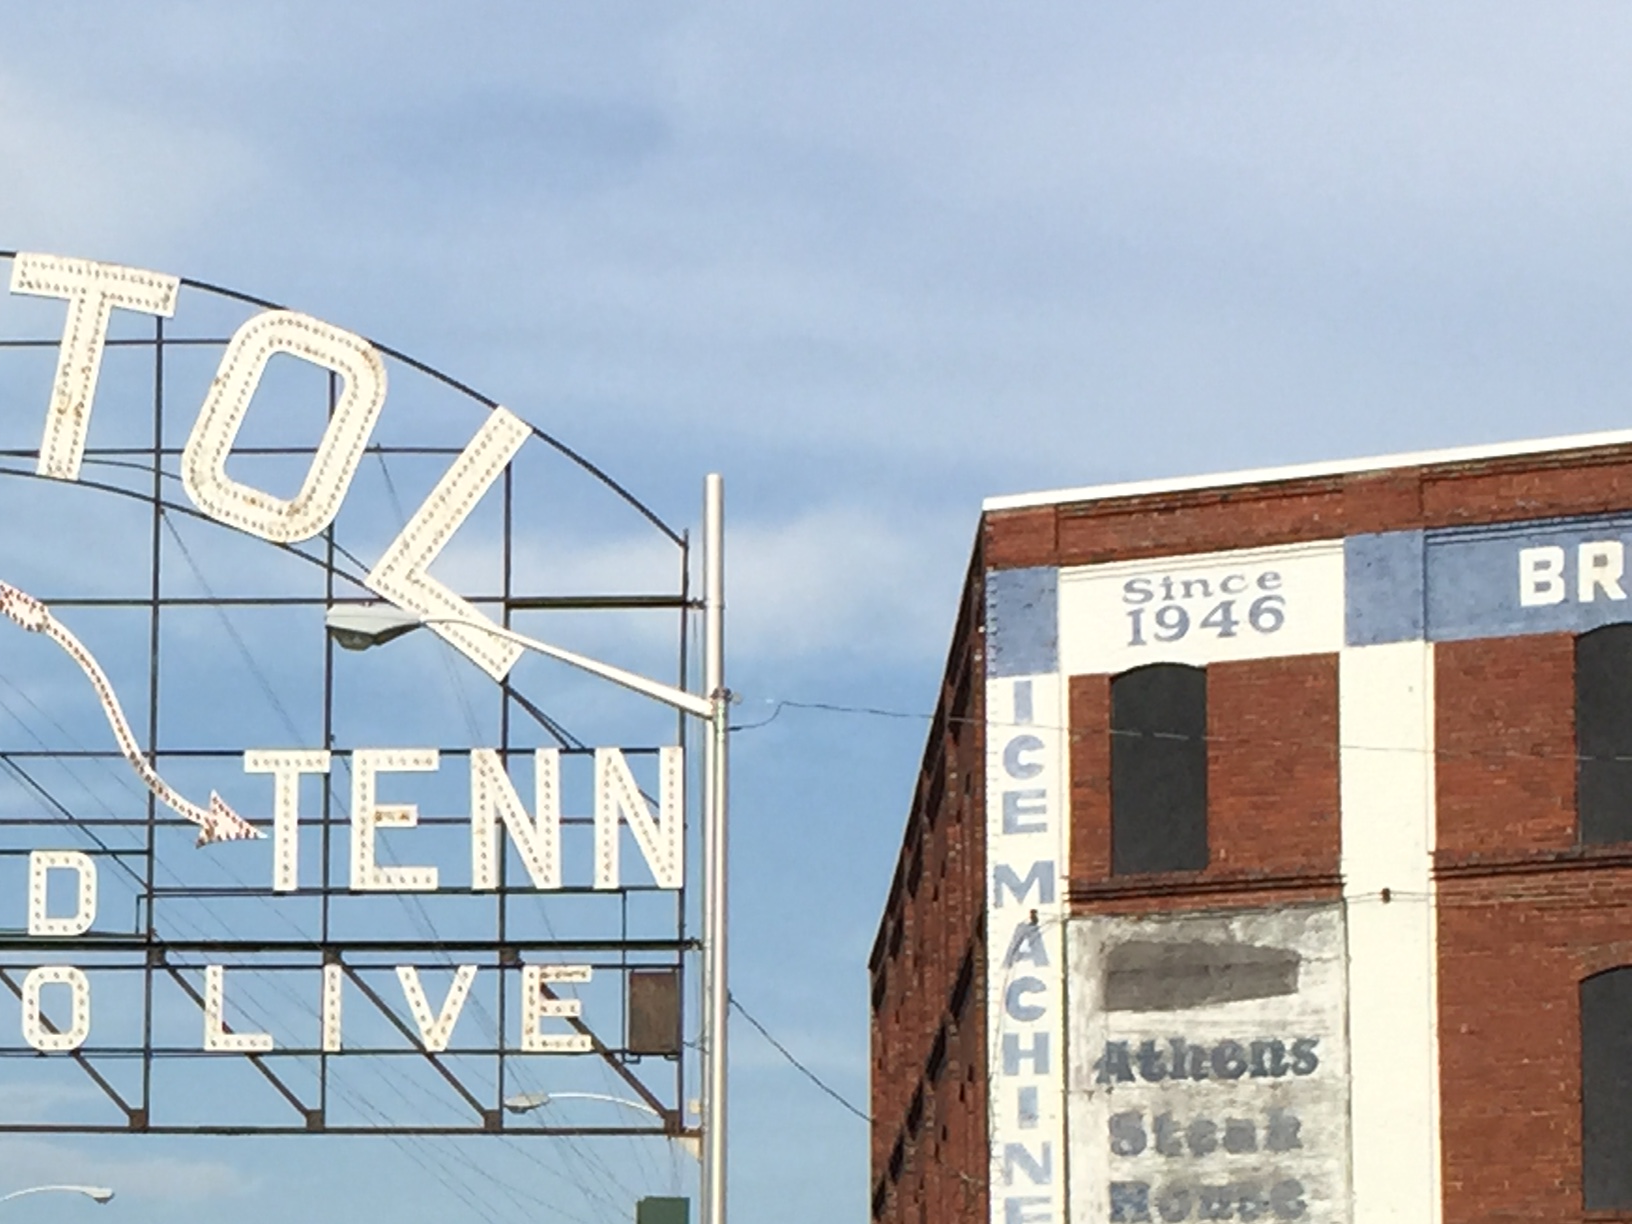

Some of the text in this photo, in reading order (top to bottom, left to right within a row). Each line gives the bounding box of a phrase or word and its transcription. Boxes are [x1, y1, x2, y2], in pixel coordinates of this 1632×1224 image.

[1122, 571, 1283, 605] Since
[1126, 595, 1286, 646] 1946
[1002, 680, 1048, 835] ICE
[244, 748, 684, 892] TENN
[204, 964, 592, 1052] LIVE
[1093, 1035, 1320, 1084] Athens
